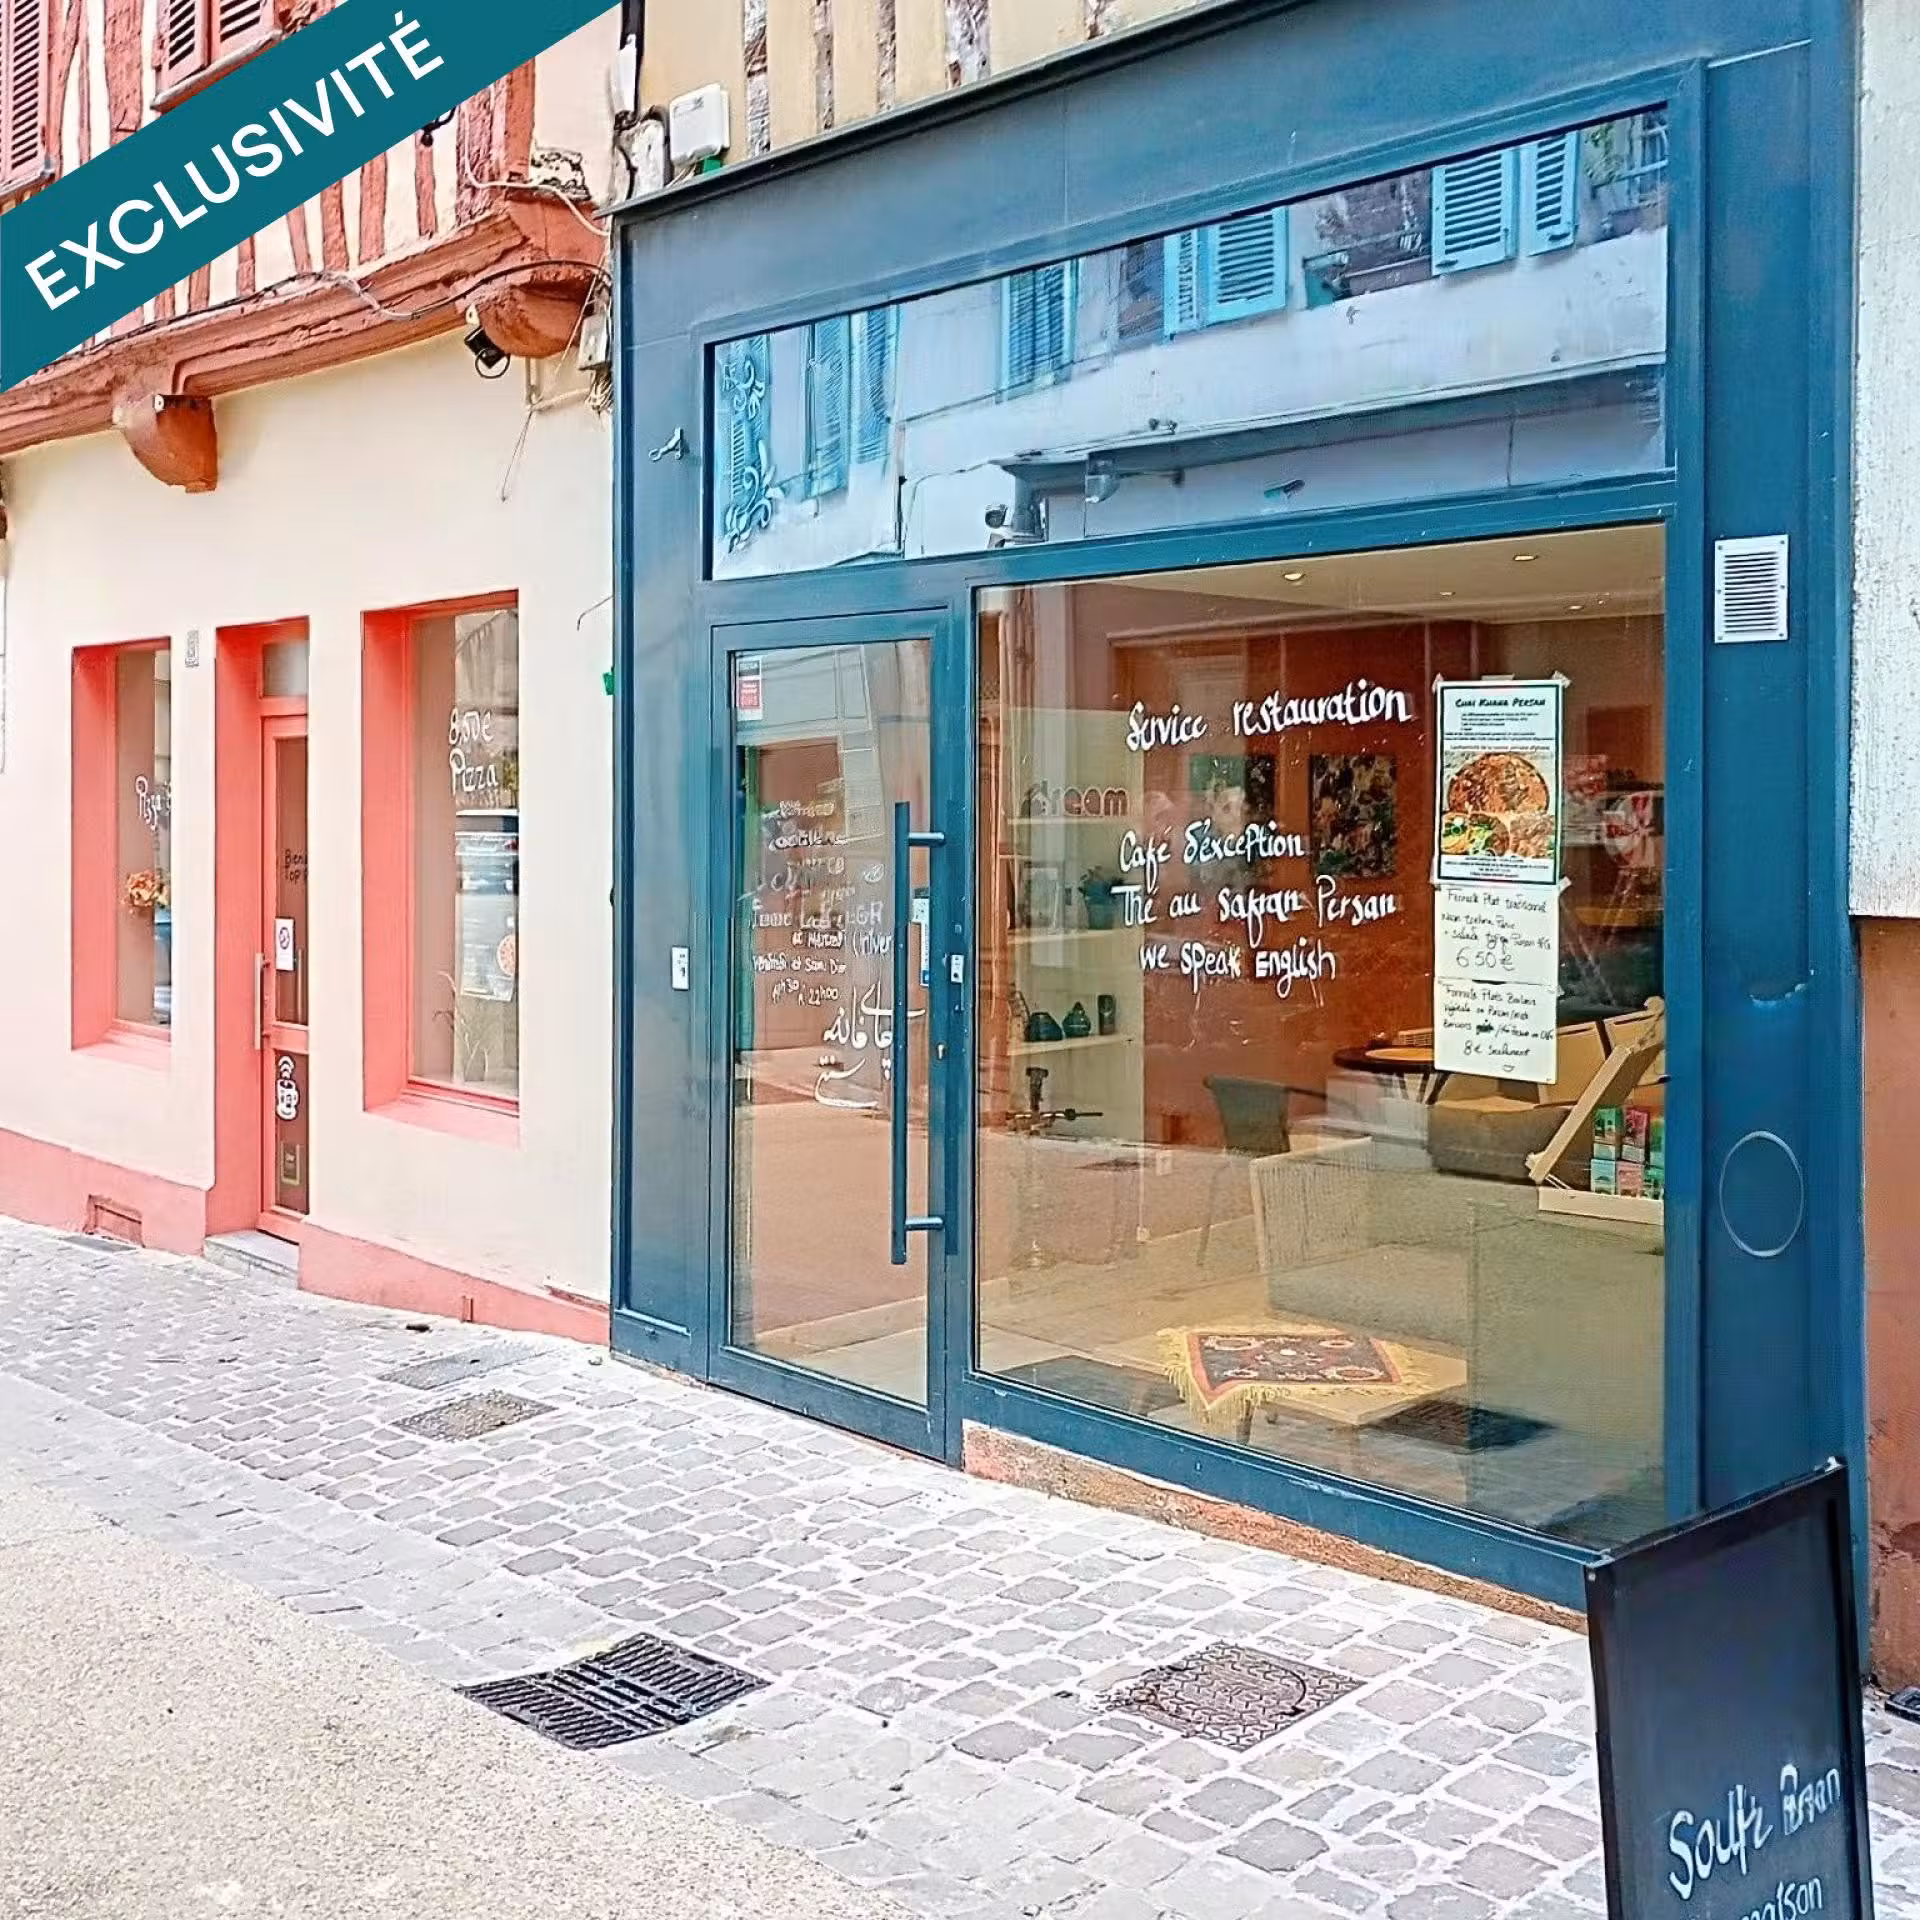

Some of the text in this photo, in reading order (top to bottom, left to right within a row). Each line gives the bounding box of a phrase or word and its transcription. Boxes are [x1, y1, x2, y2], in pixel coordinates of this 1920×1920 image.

[1127, 678, 1412, 750] Service restauration
[1120, 825, 1171, 895] Café
[1111, 885, 1158, 926] Thé
[1169, 893, 1201, 917] au
[1315, 875, 1396, 927] Persan
